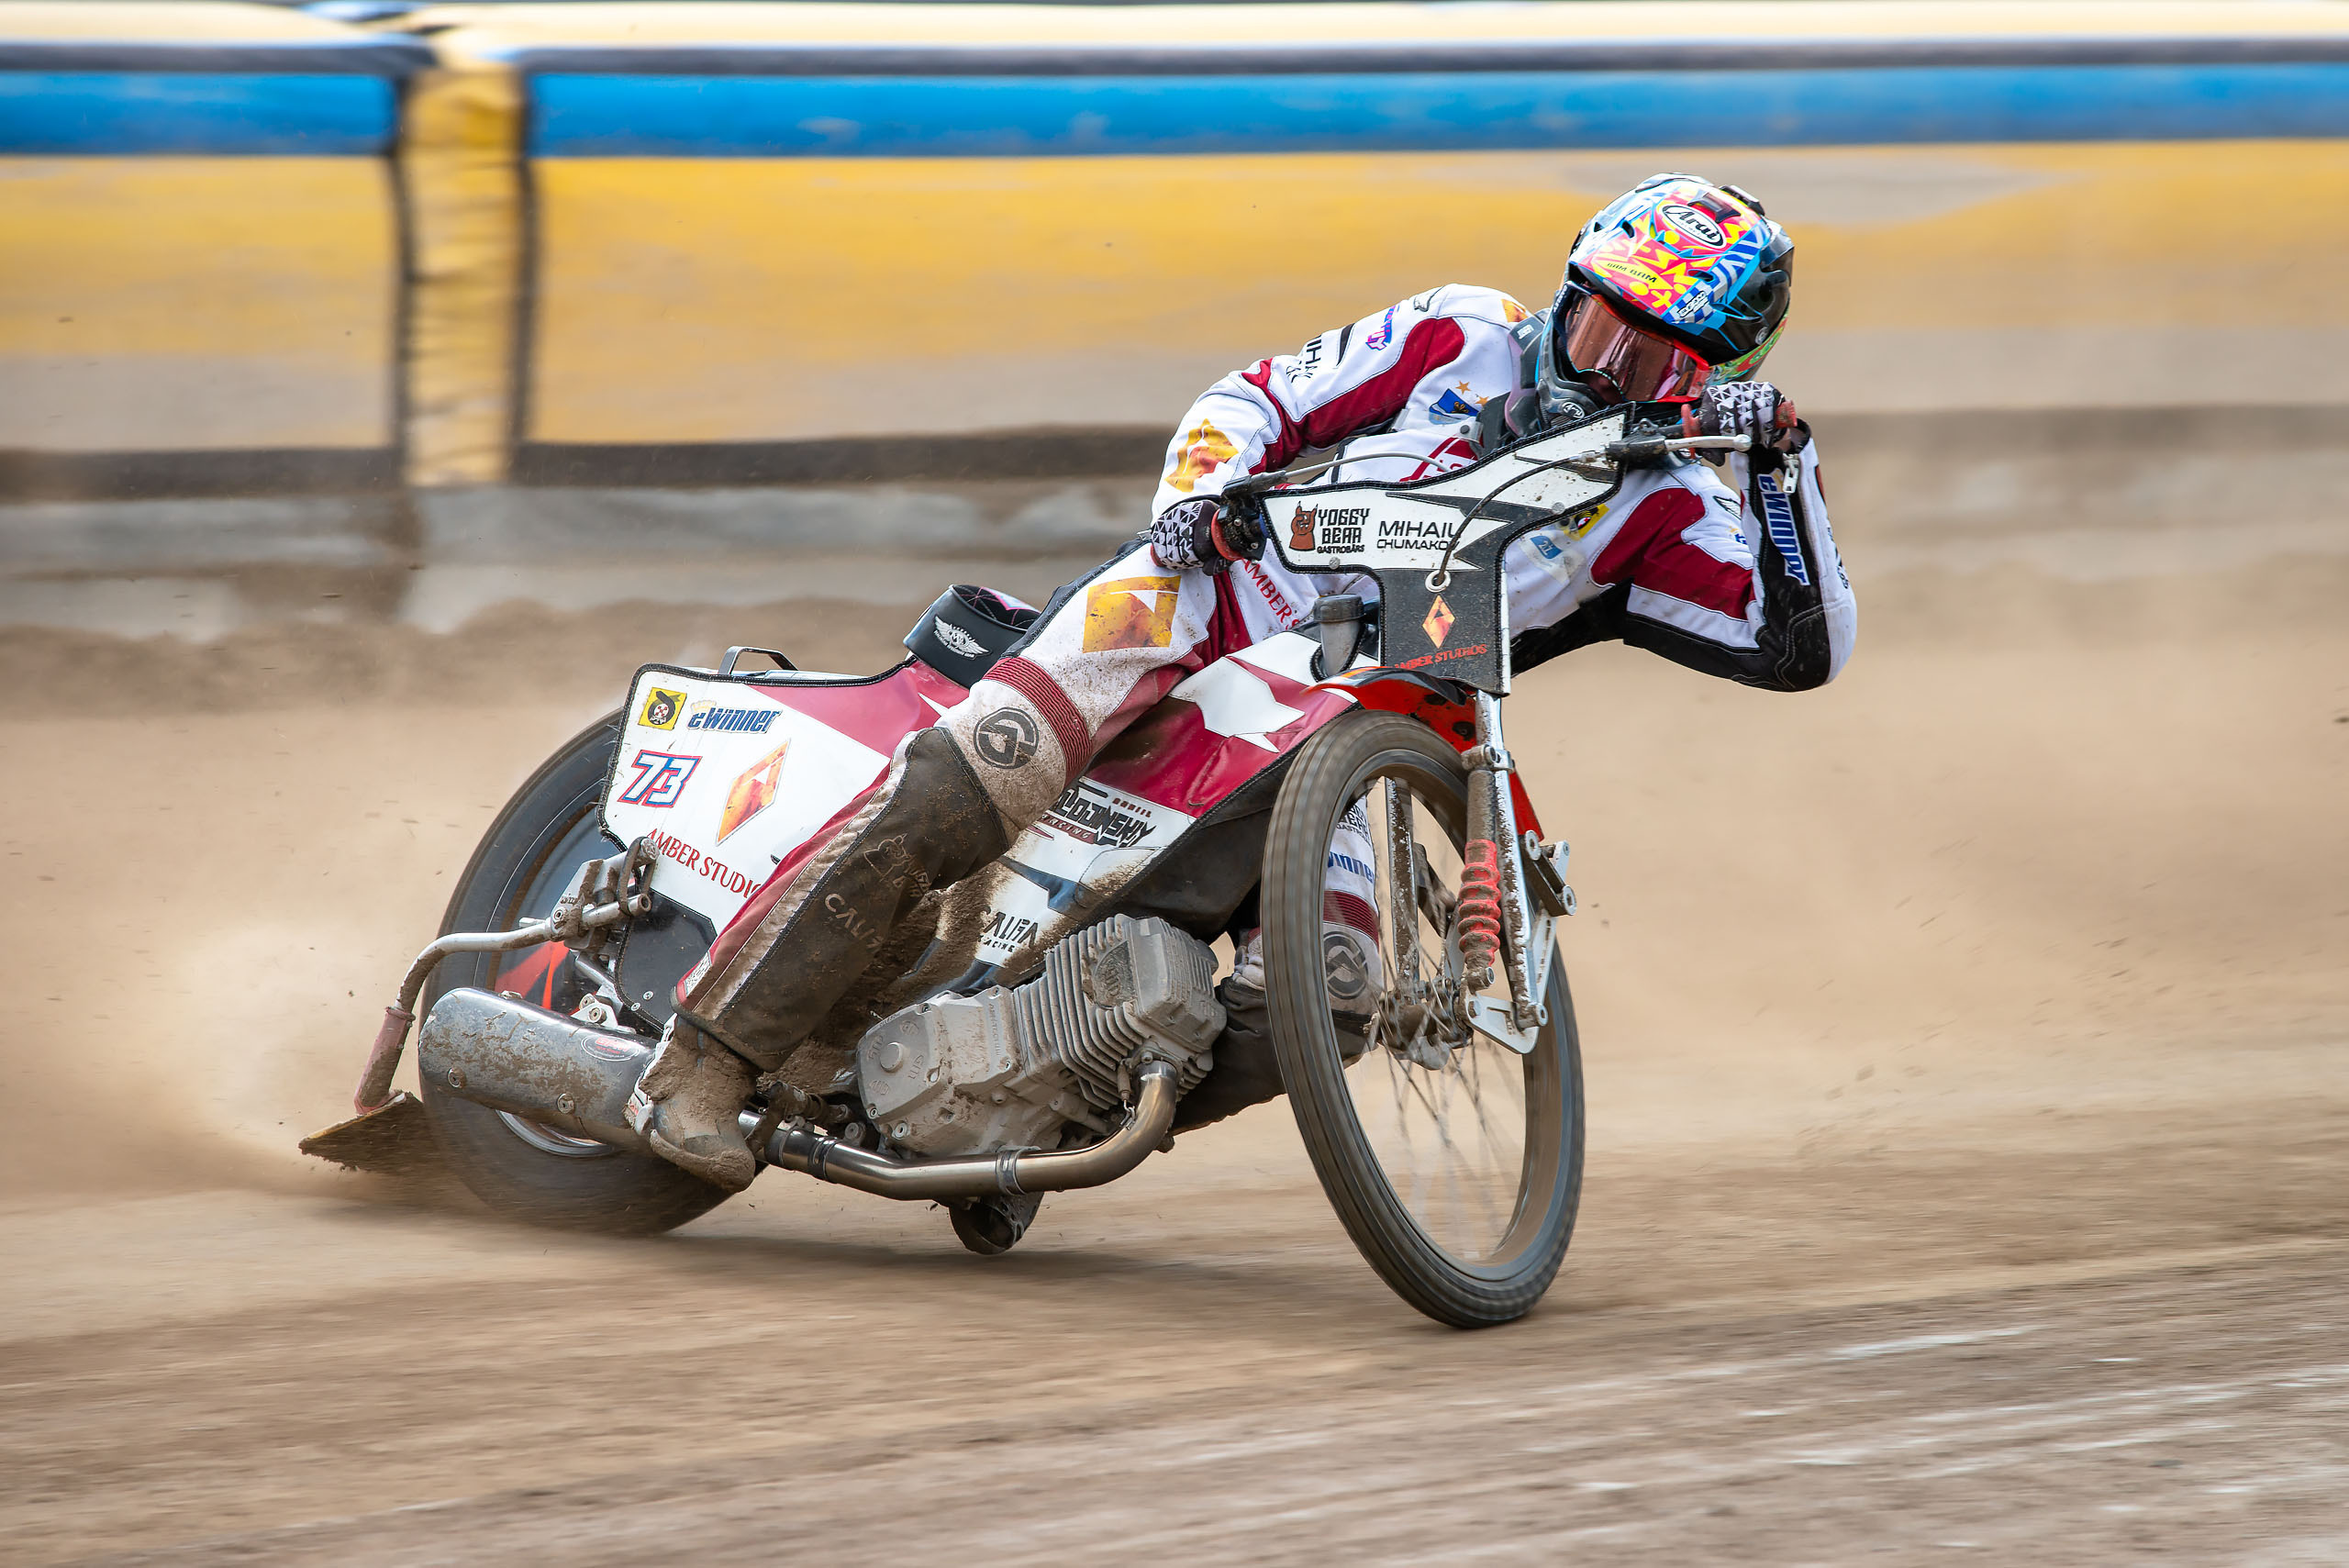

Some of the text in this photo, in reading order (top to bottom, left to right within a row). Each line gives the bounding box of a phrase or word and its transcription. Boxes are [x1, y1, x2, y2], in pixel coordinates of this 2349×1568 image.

[1664, 210, 1720, 239] Arai
[1321, 527, 1363, 544] BEAR
[1378, 520, 1461, 539] MIHAIL
[1242, 558, 1292, 624] AMBER
[1434, 643, 1487, 663] STUDIOS
[688, 707, 781, 732] eWinner
[618, 750, 703, 808] 73
